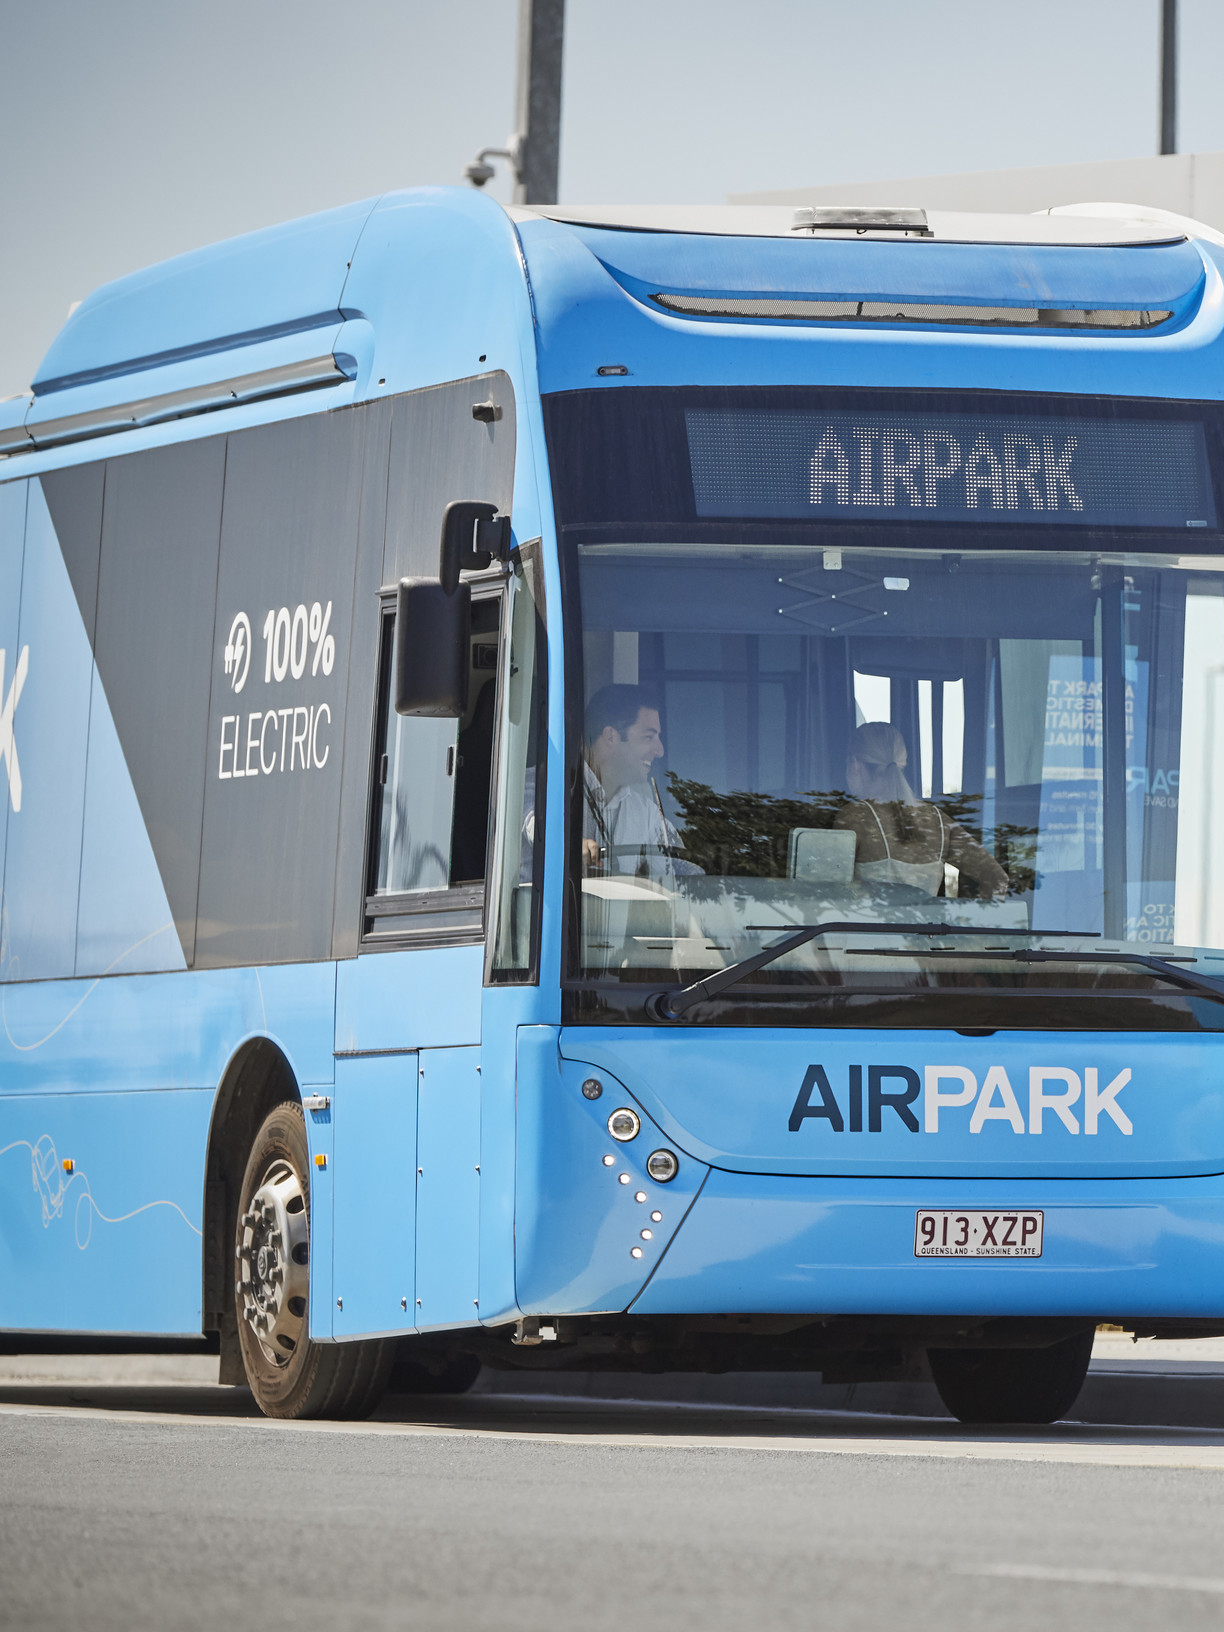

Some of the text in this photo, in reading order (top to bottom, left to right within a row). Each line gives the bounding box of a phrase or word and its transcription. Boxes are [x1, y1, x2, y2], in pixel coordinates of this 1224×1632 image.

[810, 426, 1083, 510] AIRPARK
[263, 600, 336, 683] 100%
[218, 703, 331, 779] ELECTRIC
[788, 1064, 1133, 1135] AIRPARK
[921, 1247, 968, 1255] QUEENSLAND
